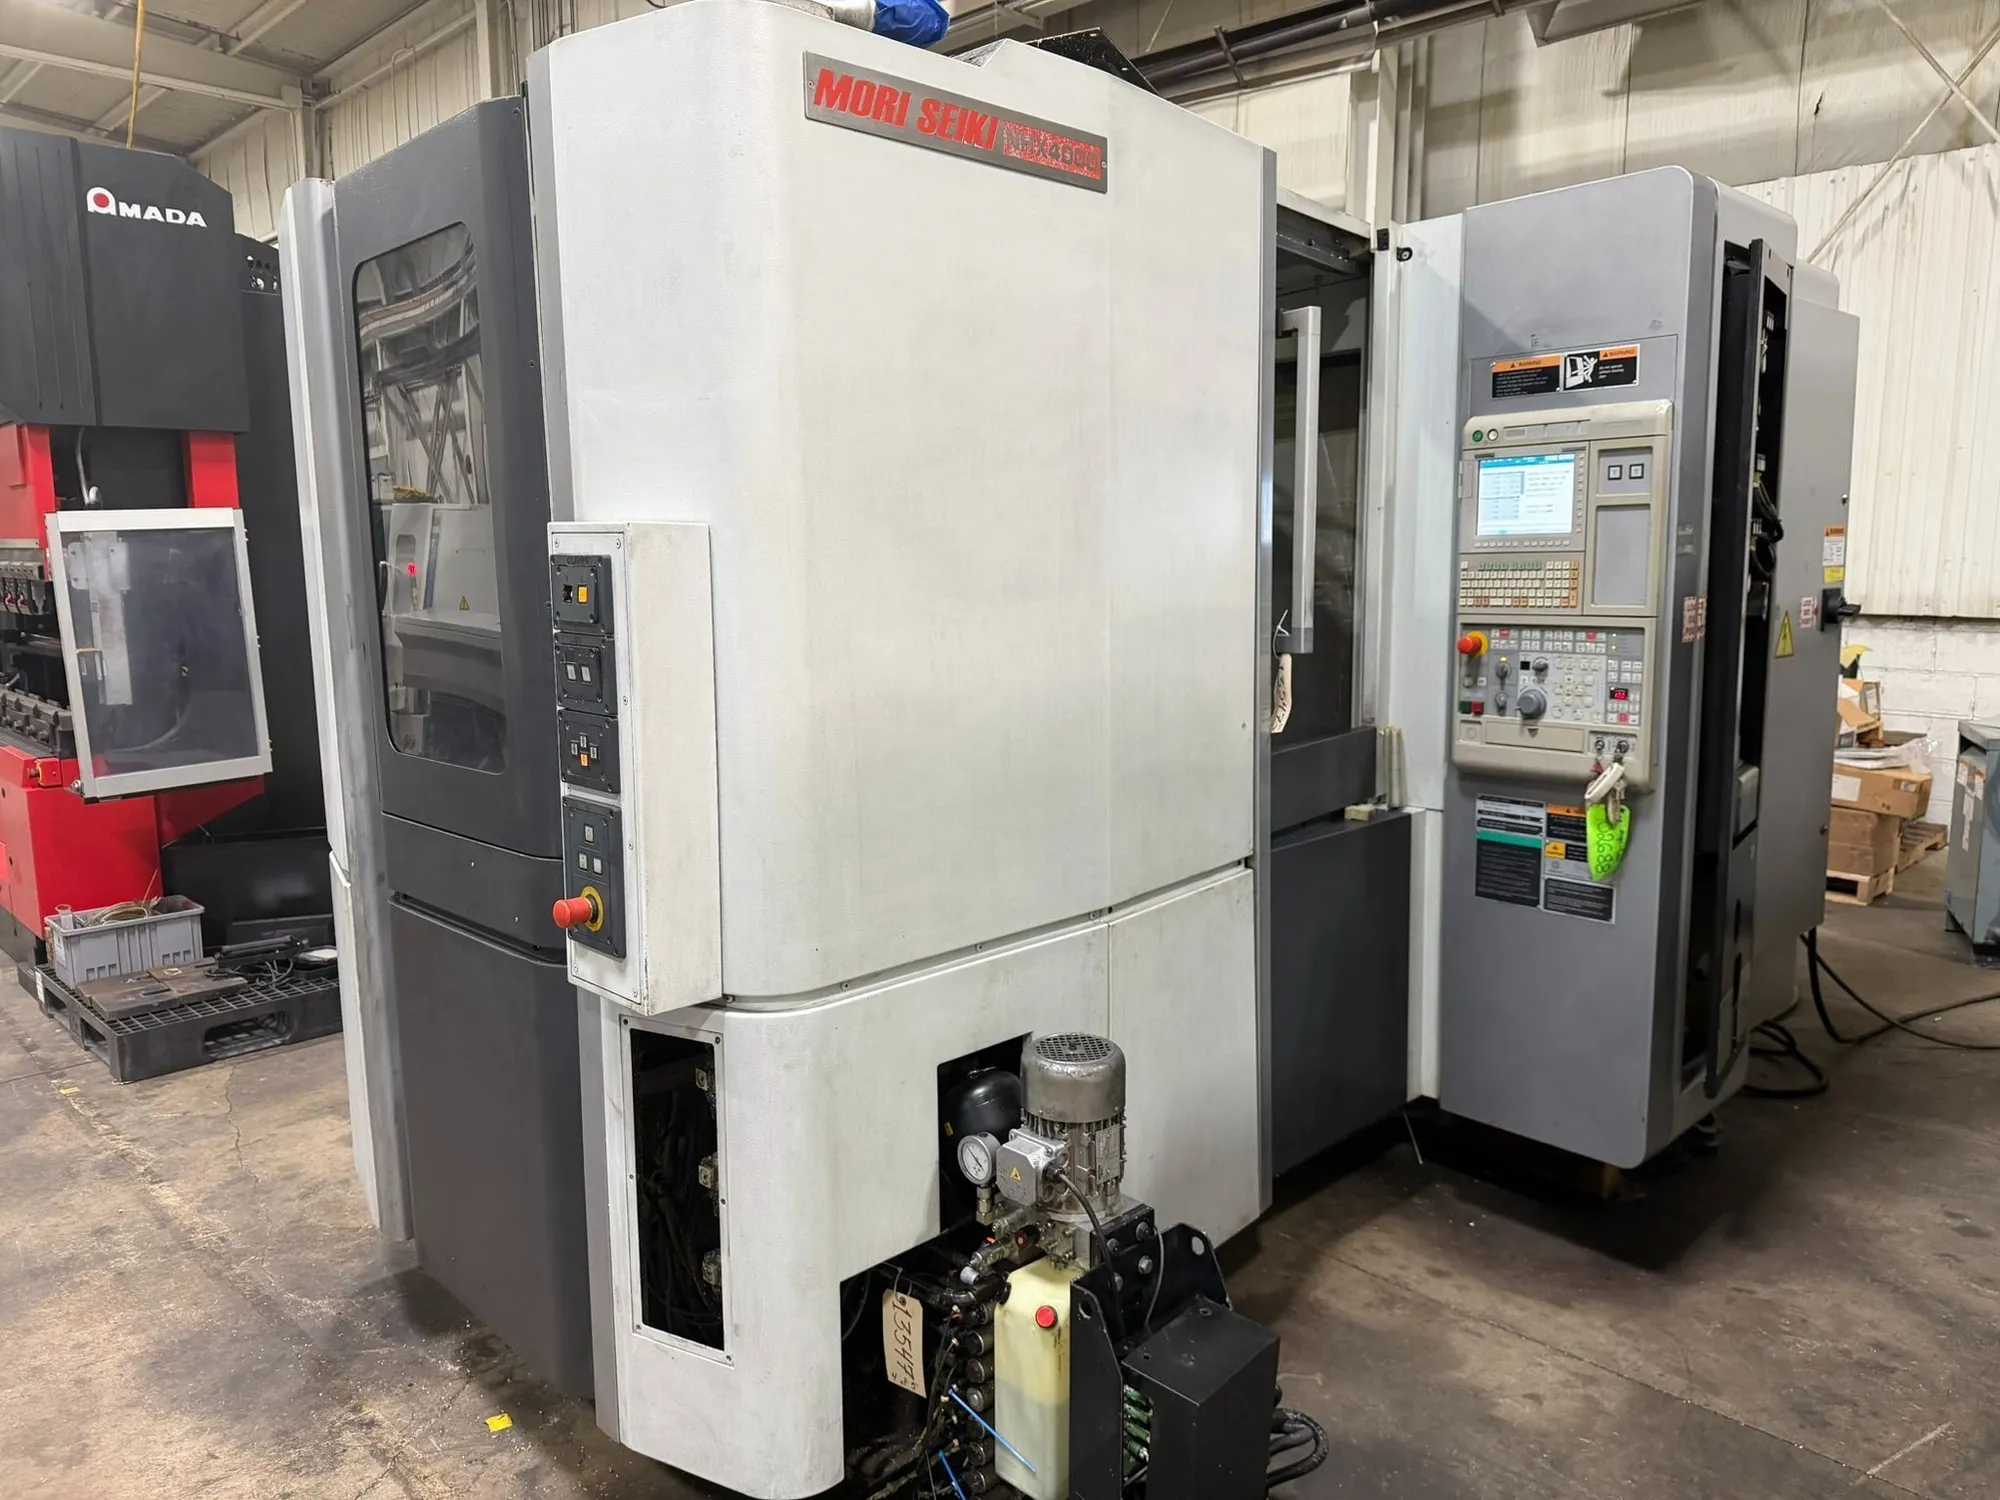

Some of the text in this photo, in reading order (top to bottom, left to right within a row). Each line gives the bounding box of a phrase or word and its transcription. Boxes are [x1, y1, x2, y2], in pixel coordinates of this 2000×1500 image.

[813, 68, 911, 127] MORI
[915, 97, 1000, 150] SEIKI
[86, 186, 208, 227] AMADA
[892, 1299, 915, 1382] 13547
